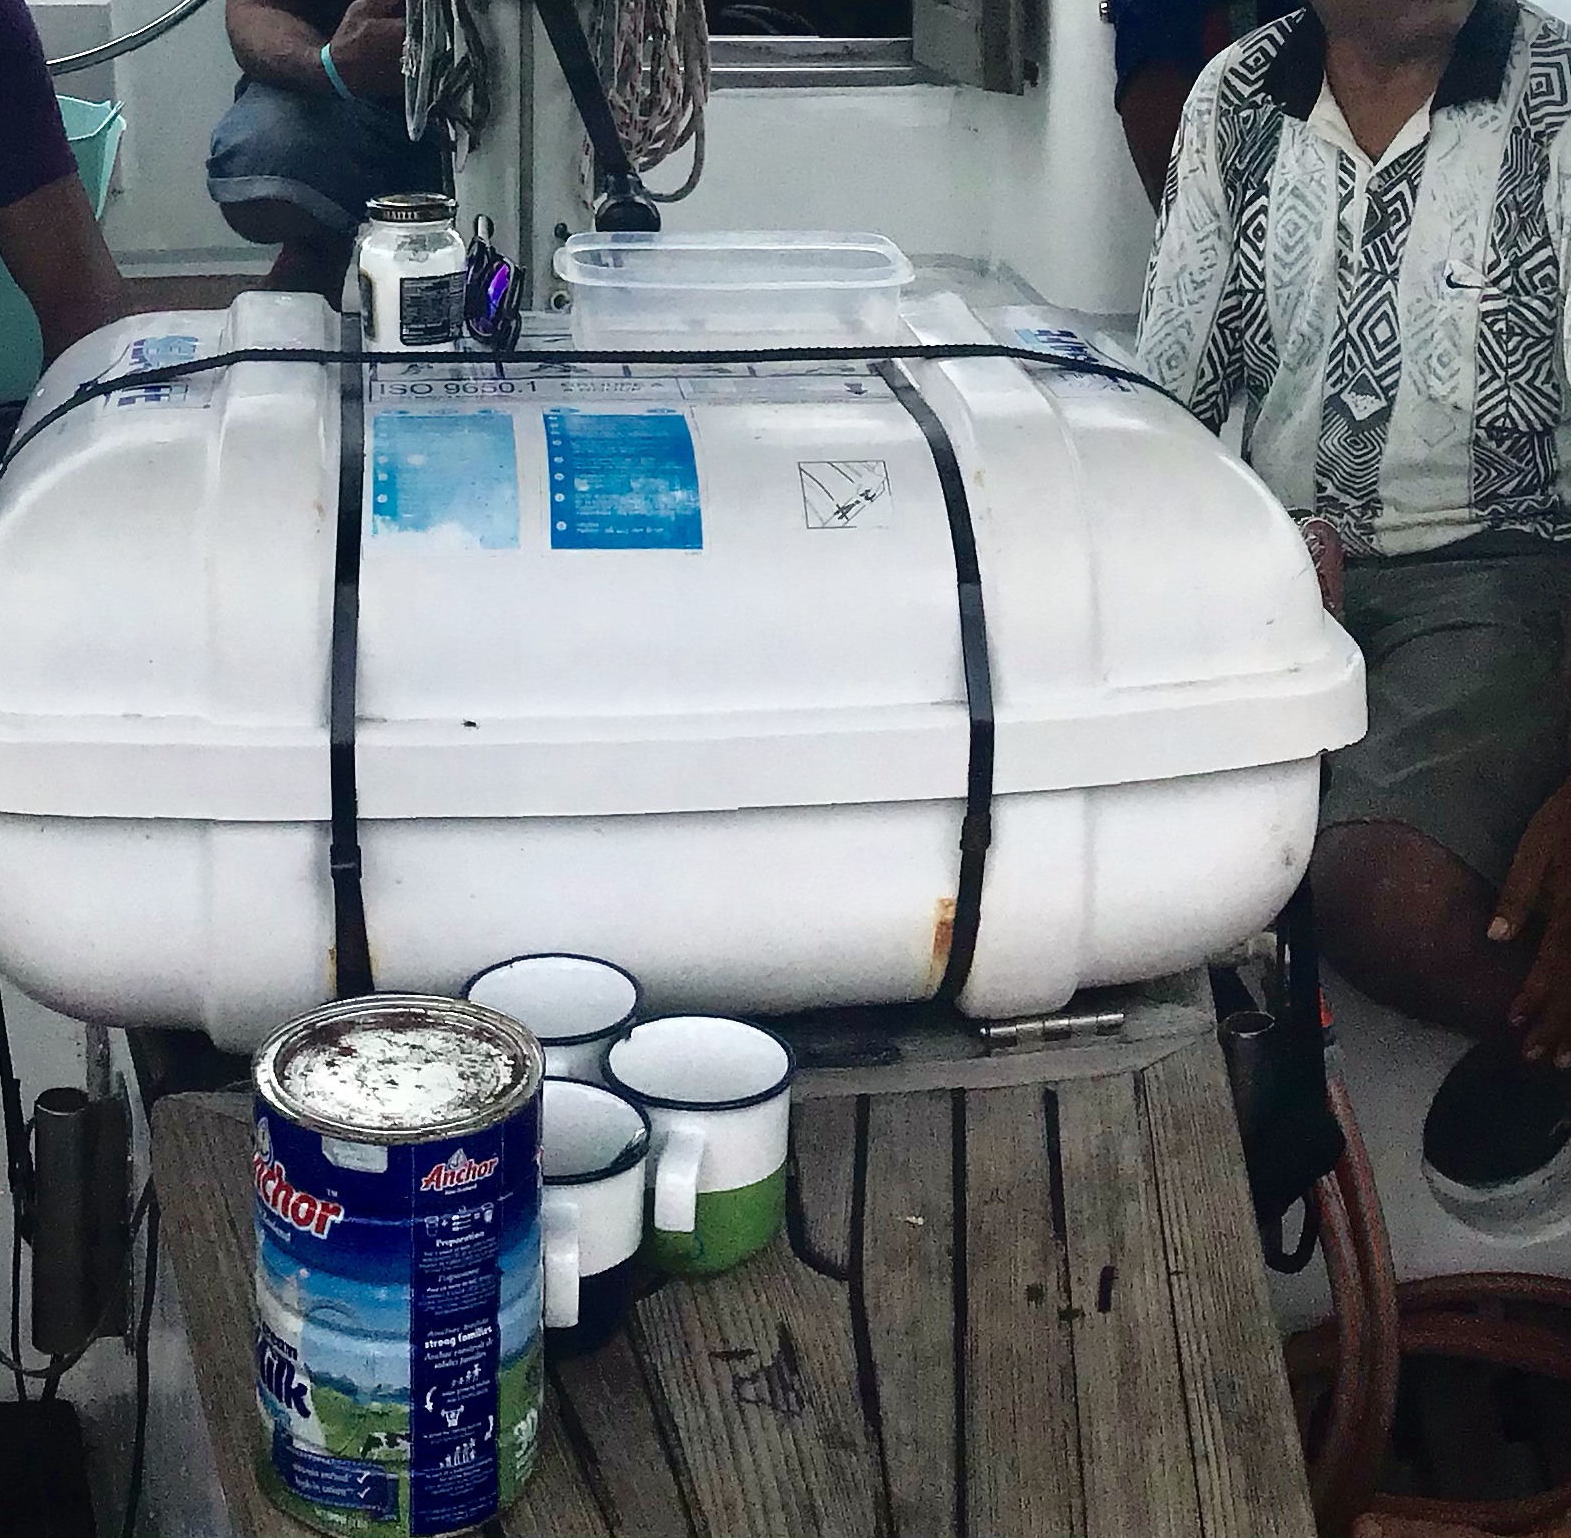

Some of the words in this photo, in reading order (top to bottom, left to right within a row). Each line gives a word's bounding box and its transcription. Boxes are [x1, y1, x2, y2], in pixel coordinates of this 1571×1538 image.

[379, 382, 434, 396] ISO
[443, 380, 539, 396] 9650.1
[420, 1154, 500, 1193] Anchor
[253, 1152, 345, 1240] nchor
[424, 1336, 457, 1350] strong
[457, 1325, 493, 1343] families
